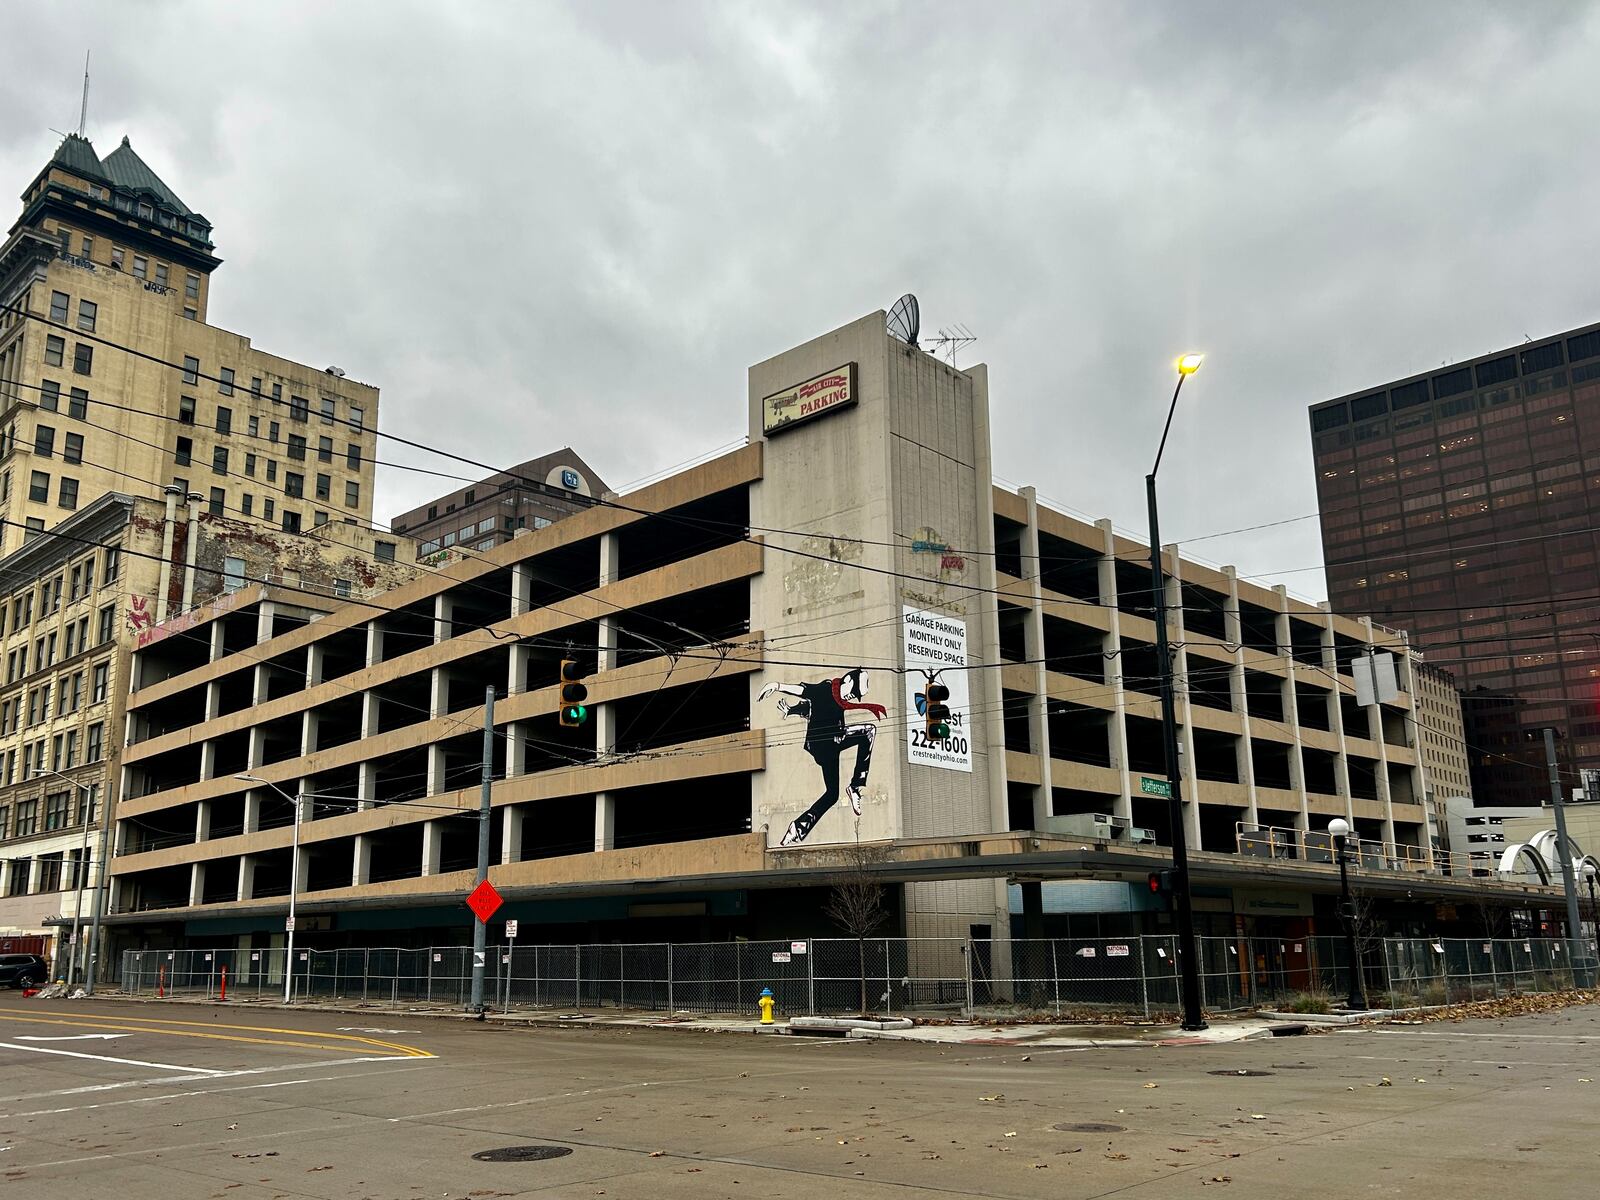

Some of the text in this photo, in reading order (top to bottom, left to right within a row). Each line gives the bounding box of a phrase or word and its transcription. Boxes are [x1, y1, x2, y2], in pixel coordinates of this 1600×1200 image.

[823, 379, 835, 387] CITY
[800, 387, 847, 415] PARKING
[905, 613, 964, 637] GARAGE PARKING
[909, 629, 961, 650] MONTHLY ONLY
[908, 643, 964, 666] RESERVED SPACE
[912, 750, 968, 764] crestrealtyohio.com
[1145, 780, 1166, 795] Jefferson
